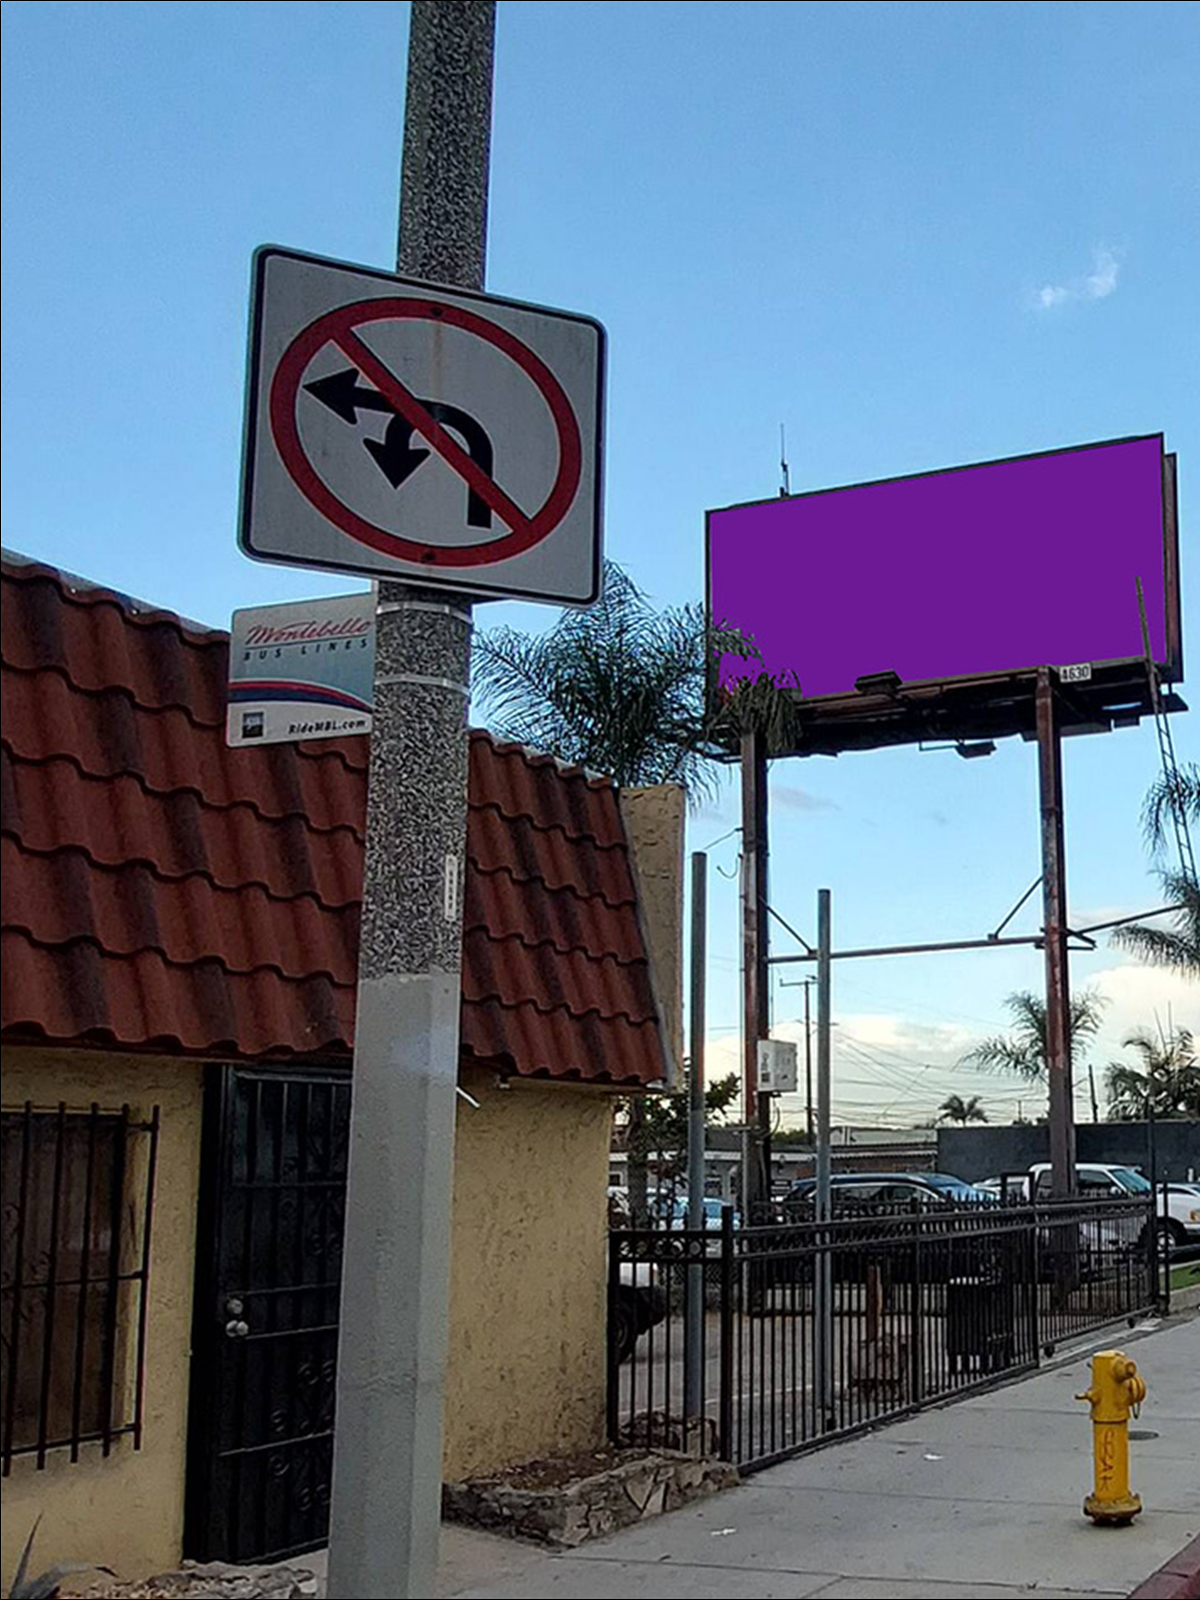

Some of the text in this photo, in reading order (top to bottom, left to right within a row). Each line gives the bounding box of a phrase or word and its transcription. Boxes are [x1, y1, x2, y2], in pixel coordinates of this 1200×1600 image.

[244, 617, 371, 646] Montebello
[243, 638, 367, 661] BUS LINES
[1063, 666, 1089, 680] 4630
[288, 719, 366, 735] RideMBL.com
